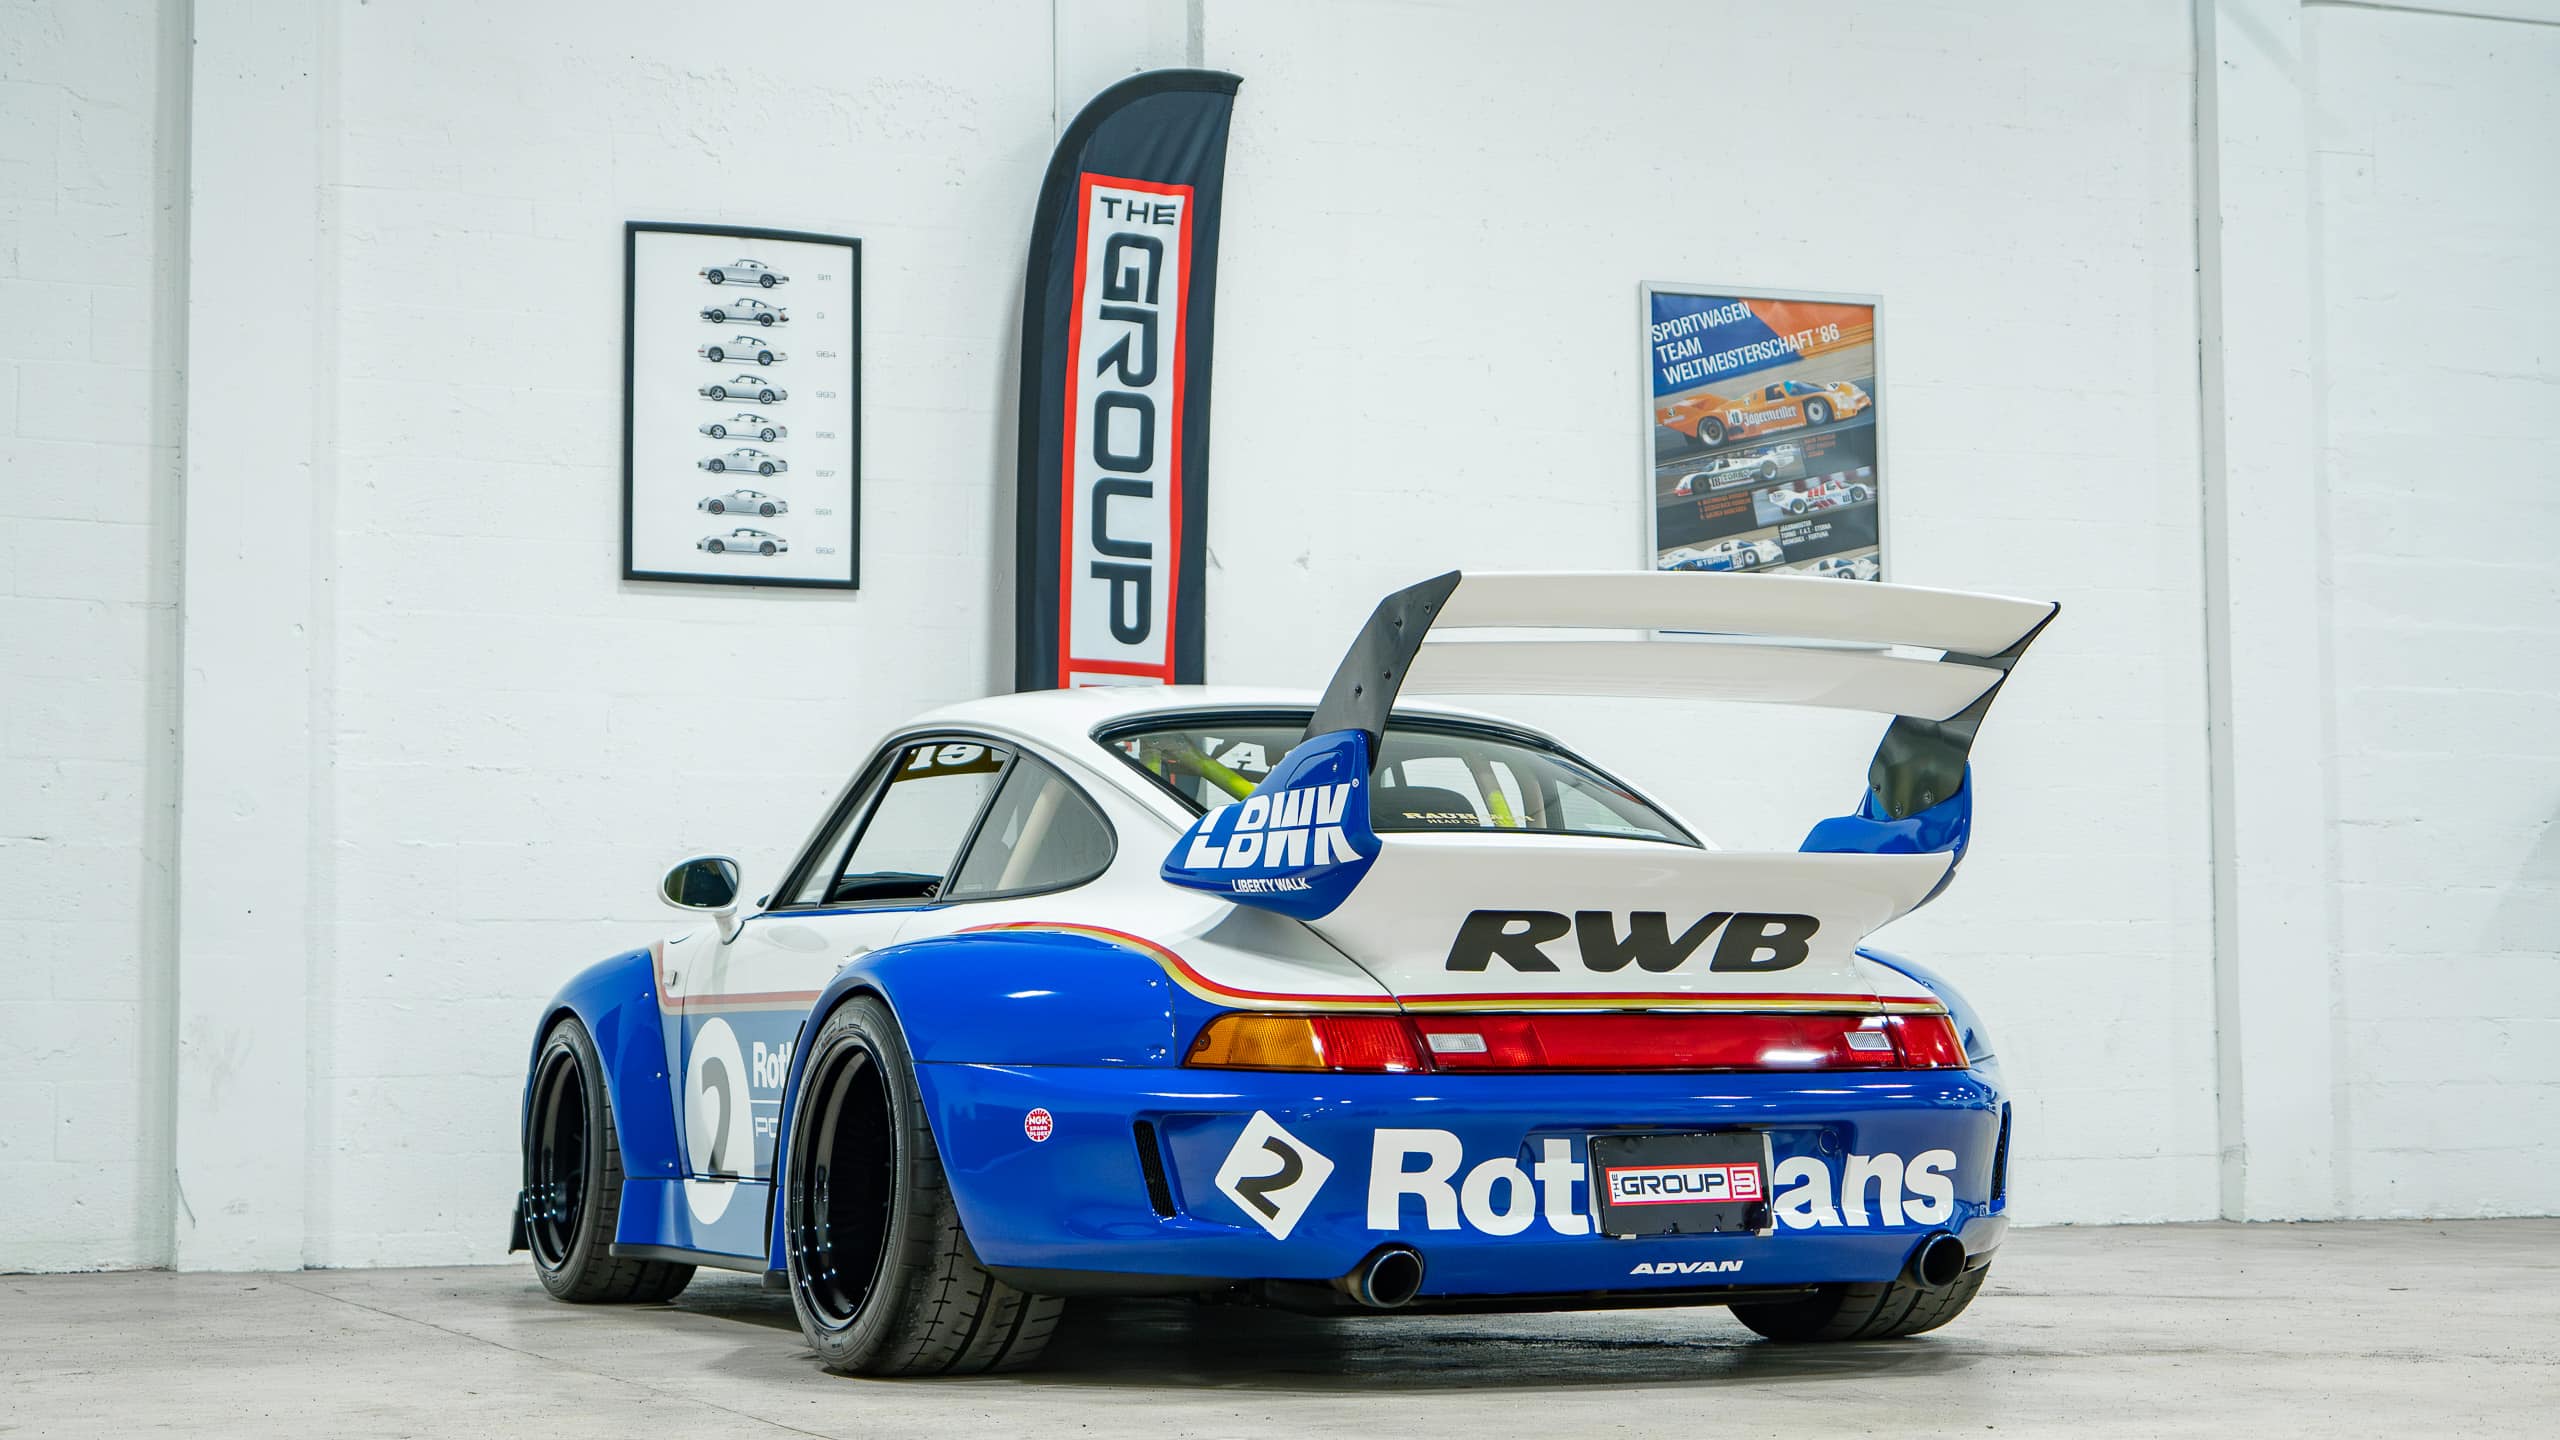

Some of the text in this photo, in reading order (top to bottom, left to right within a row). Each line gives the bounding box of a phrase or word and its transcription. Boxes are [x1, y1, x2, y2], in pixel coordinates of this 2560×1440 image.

[1100, 196, 1177, 226] THE
[1651, 302, 1753, 342] SPORTWAGEN
[1655, 336, 1703, 364] TEAM
[1662, 328, 1814, 385] WELTMEISTERSCHAFT
[1090, 231, 1165, 646] GROUP
[1184, 783, 1364, 868] LBWK
[1231, 876, 1313, 893] LIBERTY WALK
[1445, 909, 1821, 973] RWB
[1029, 1116, 1048, 1125] NGK
[1234, 1135, 1304, 1221] 2
[1611, 1173, 1621, 1200] THE
[1621, 1173, 1725, 1195] GROUP
[1629, 1260, 1744, 1275] ADVAN
